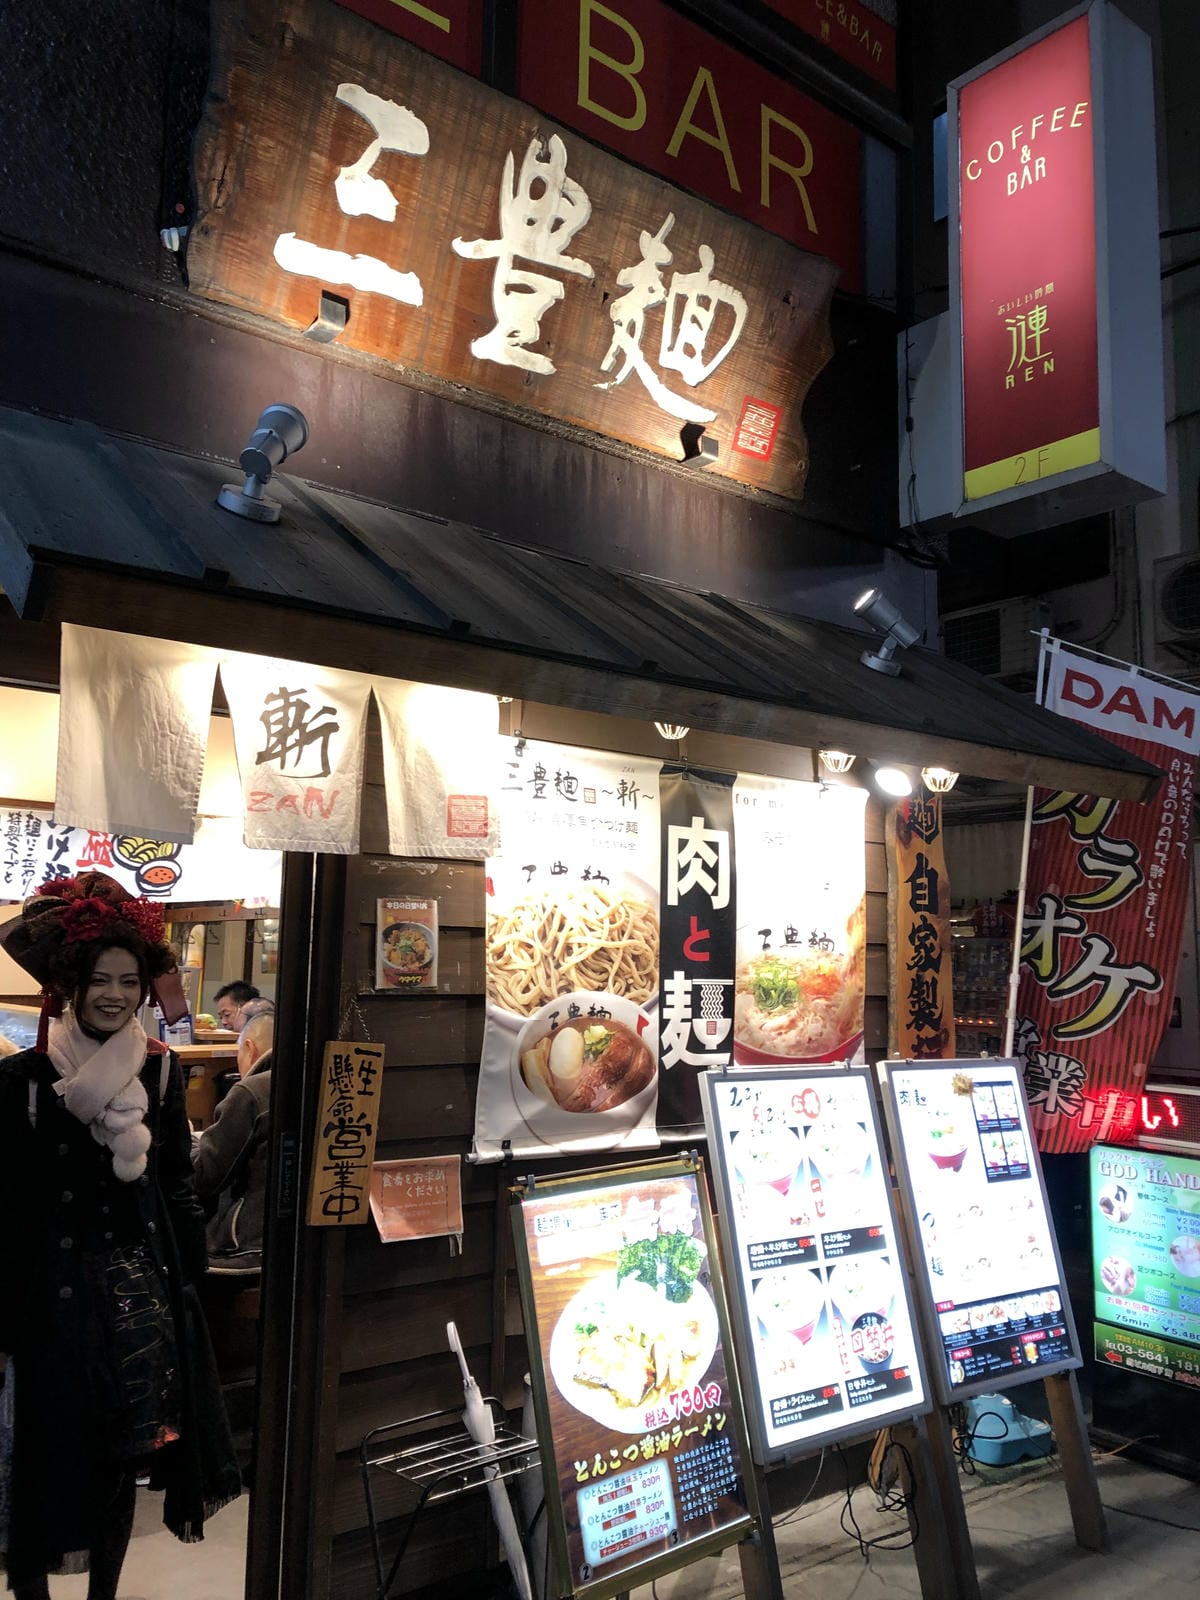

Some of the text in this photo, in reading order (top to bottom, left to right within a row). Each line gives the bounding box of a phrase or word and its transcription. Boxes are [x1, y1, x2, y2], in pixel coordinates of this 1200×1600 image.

[576, 0, 819, 236] BAR
[966, 102, 1089, 181] COFFEE
[1020, 145, 1032, 164] &
[1006, 156, 1048, 197] BAR
[1005, 357, 1056, 390] REN
[1013, 449, 1050, 486] 2F
[1060, 667, 1198, 739] DAM
[247, 787, 340, 820] ZAN
[1099, 1160, 1200, 1191] GOD HAND
[644, 1382, 722, 1429] 税込 730円
[573, 1411, 727, 1483] とんこつ醤油ラーメン
[641, 1474, 661, 1489] 830円
[645, 1499, 665, 1514] 830円
